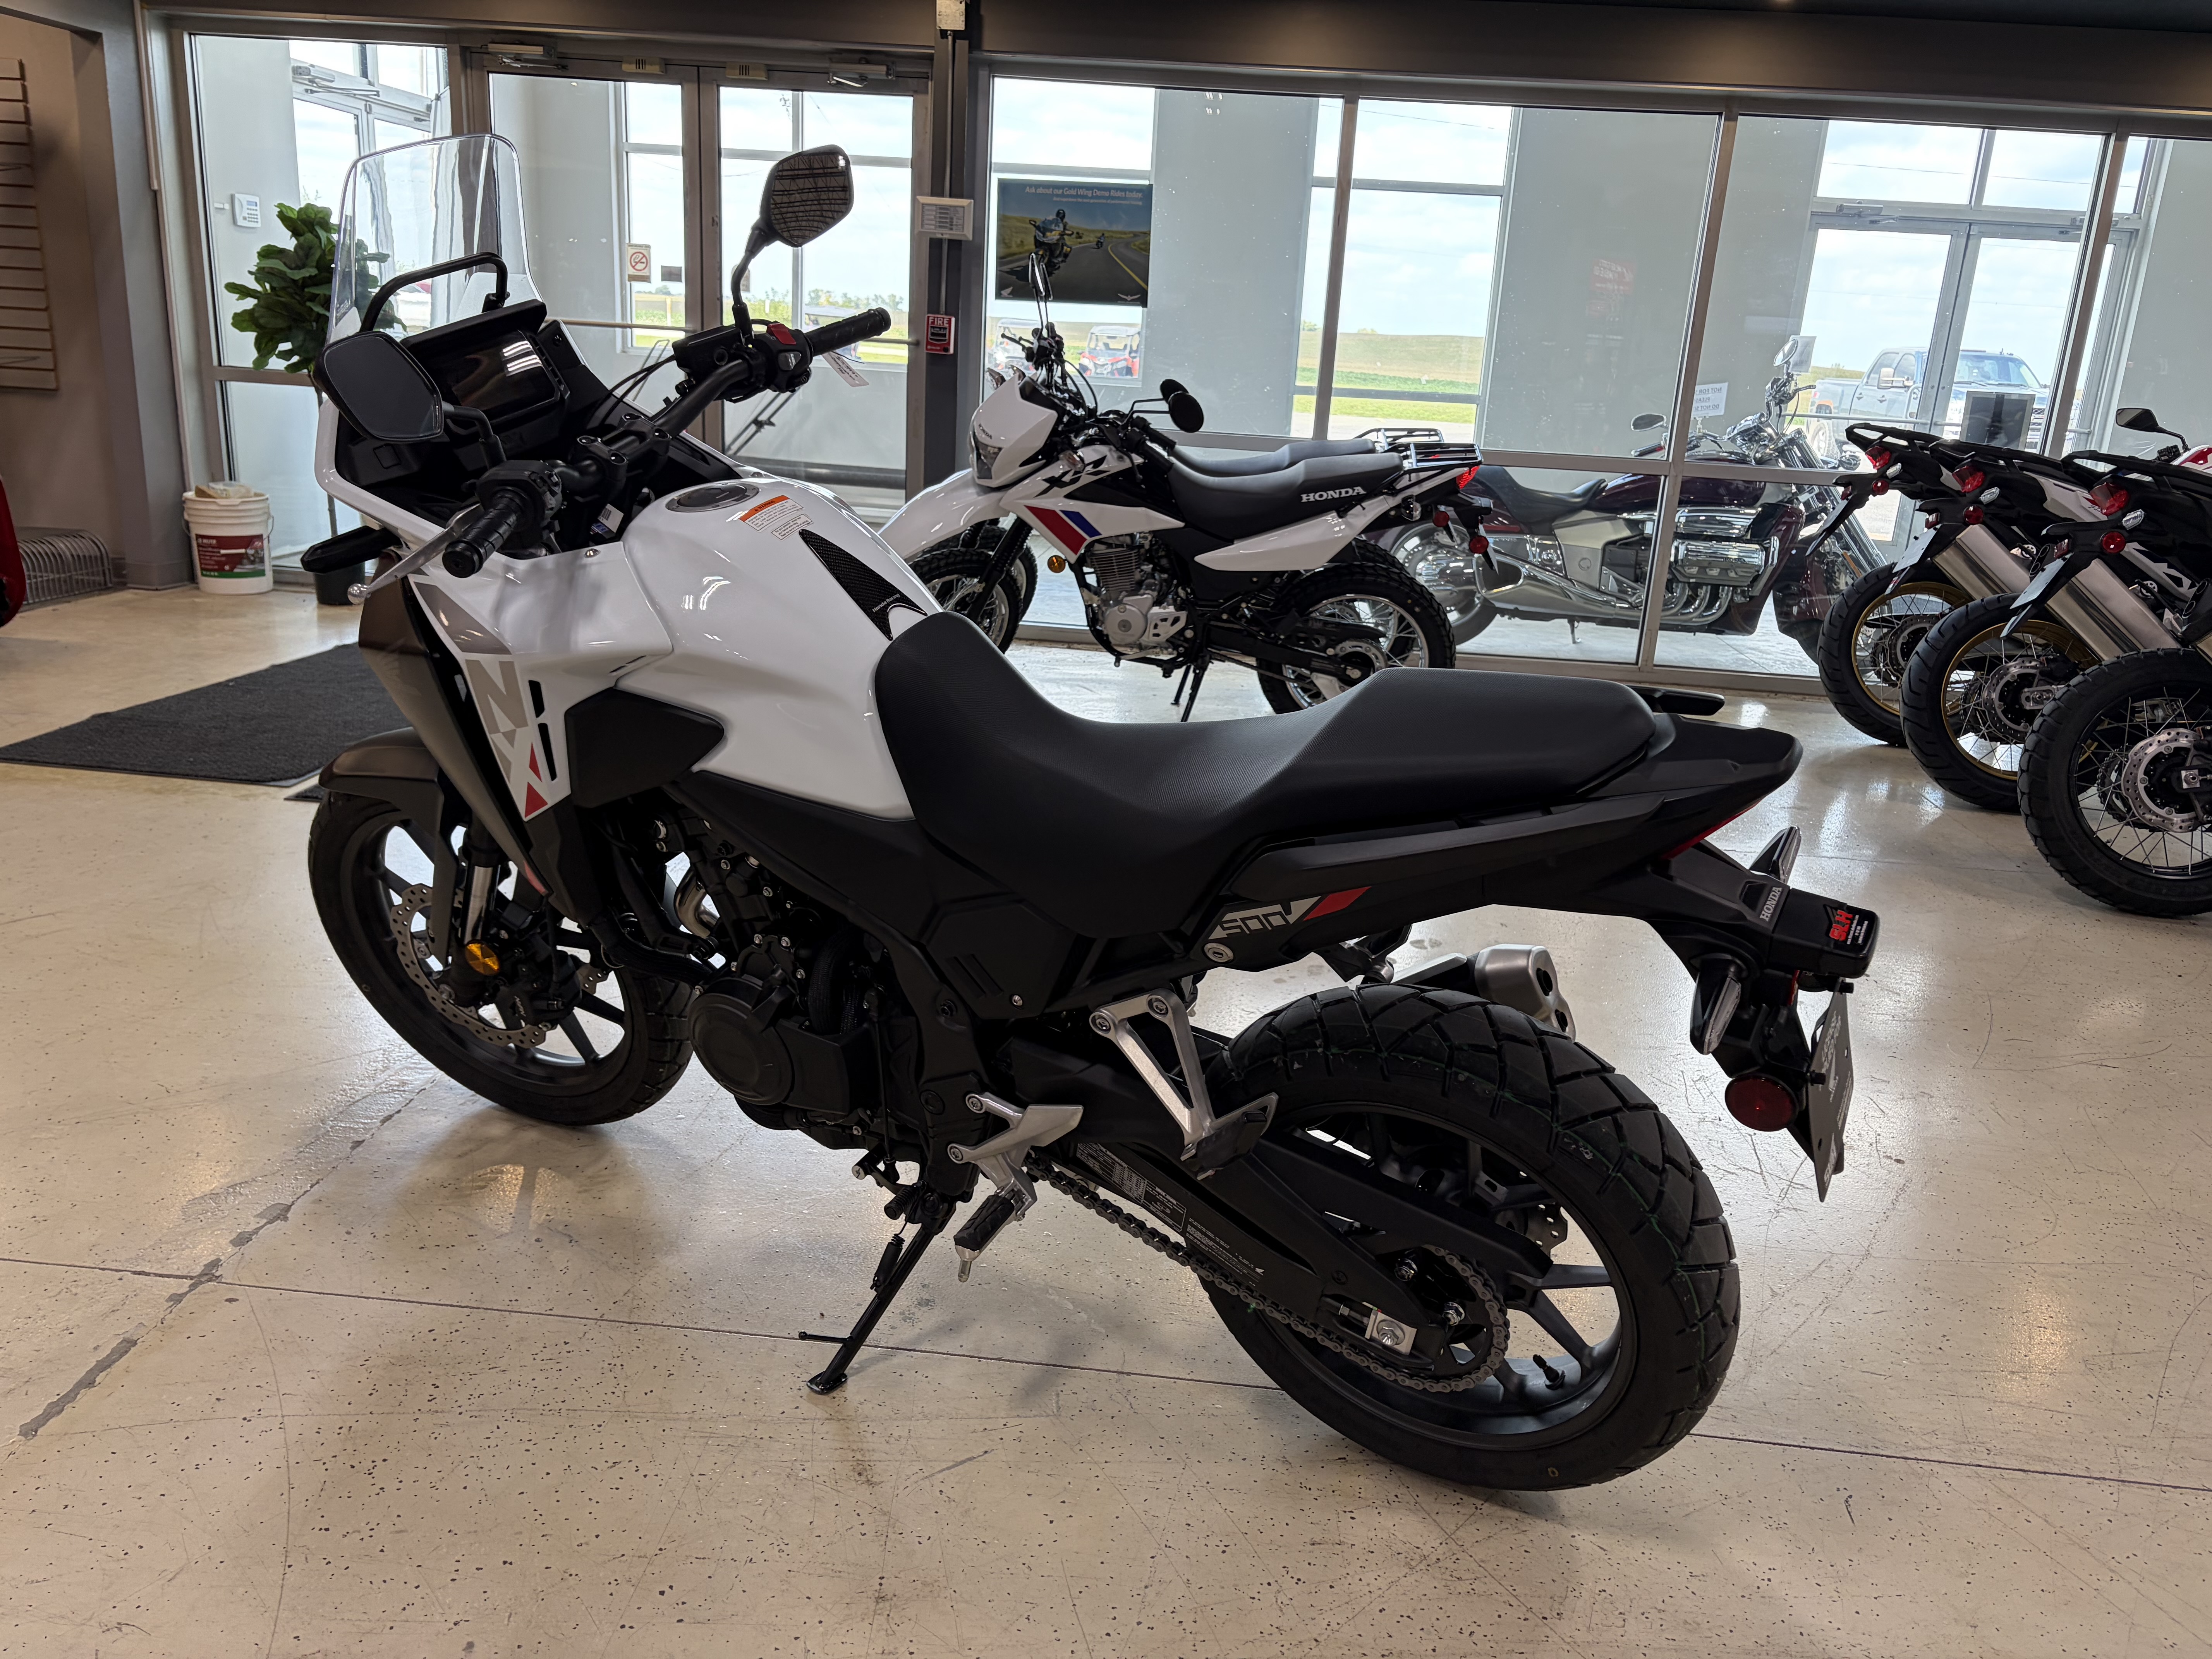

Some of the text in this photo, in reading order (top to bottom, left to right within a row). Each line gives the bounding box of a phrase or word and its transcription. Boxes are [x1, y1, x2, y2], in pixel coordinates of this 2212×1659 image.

[1077, 189, 1092, 197] Wing
[929, 317, 949, 326] FIRE
[979, 423, 992, 440] HONDA
[1300, 486, 1367, 502] HONDA
[872, 593, 900, 612] Honda Racing
[1760, 887, 1783, 922] HONDA
[1829, 910, 1853, 941] SLH
